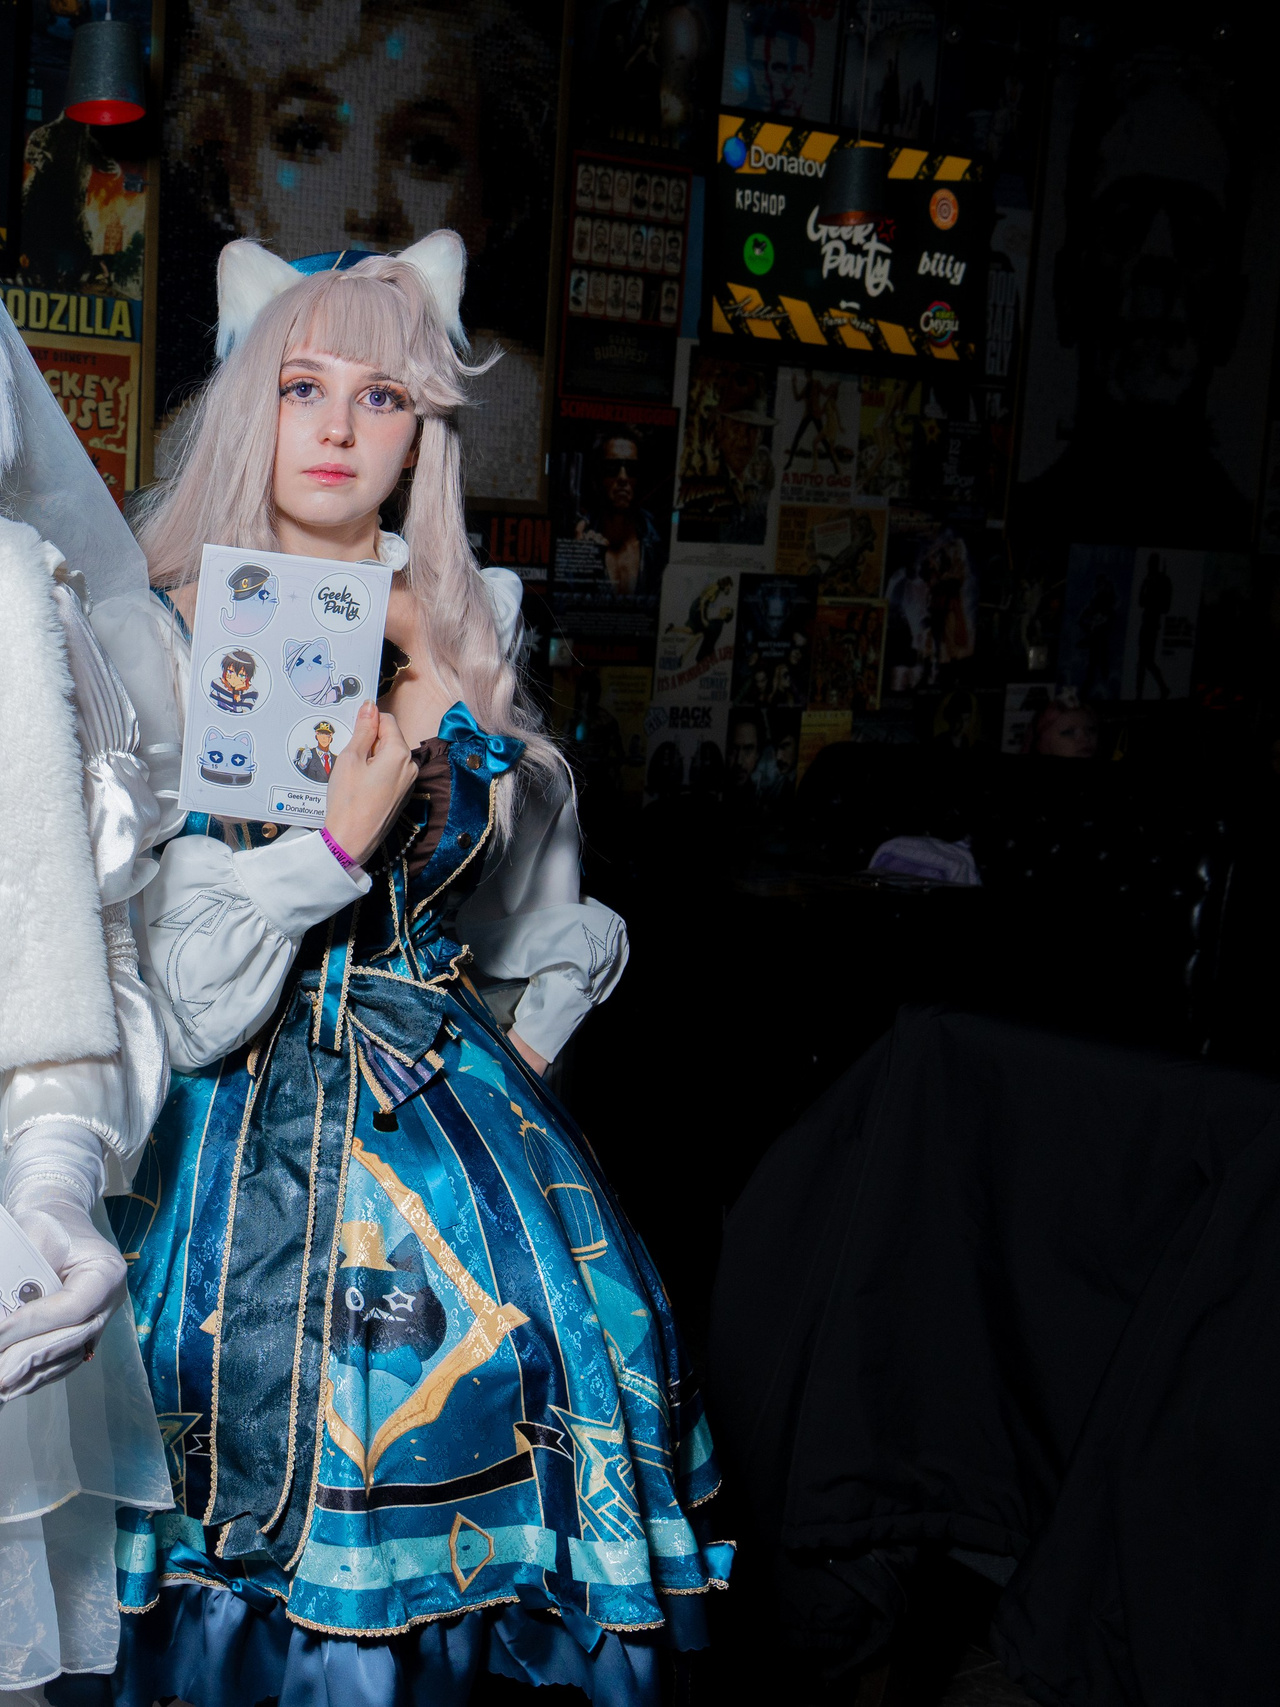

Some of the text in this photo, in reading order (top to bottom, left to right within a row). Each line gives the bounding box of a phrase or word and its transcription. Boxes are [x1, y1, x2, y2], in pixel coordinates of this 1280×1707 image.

[750, 145, 827, 178] Donatov
[735, 187, 786, 216] KPSHOP
[820, 231, 894, 297] Party
[42, 369, 120, 400] CKEY
[57, 396, 117, 430] USE
[791, 472, 824, 486] TUTTO
[826, 474, 852, 487] GAS
[489, 516, 552, 564] LEON
[317, 585, 353, 602] Geek
[323, 600, 361, 621] Party
[669, 706, 713, 720] BACK
[285, 804, 325, 816] Donatov.net
[287, 792, 322, 804] Geek Party
